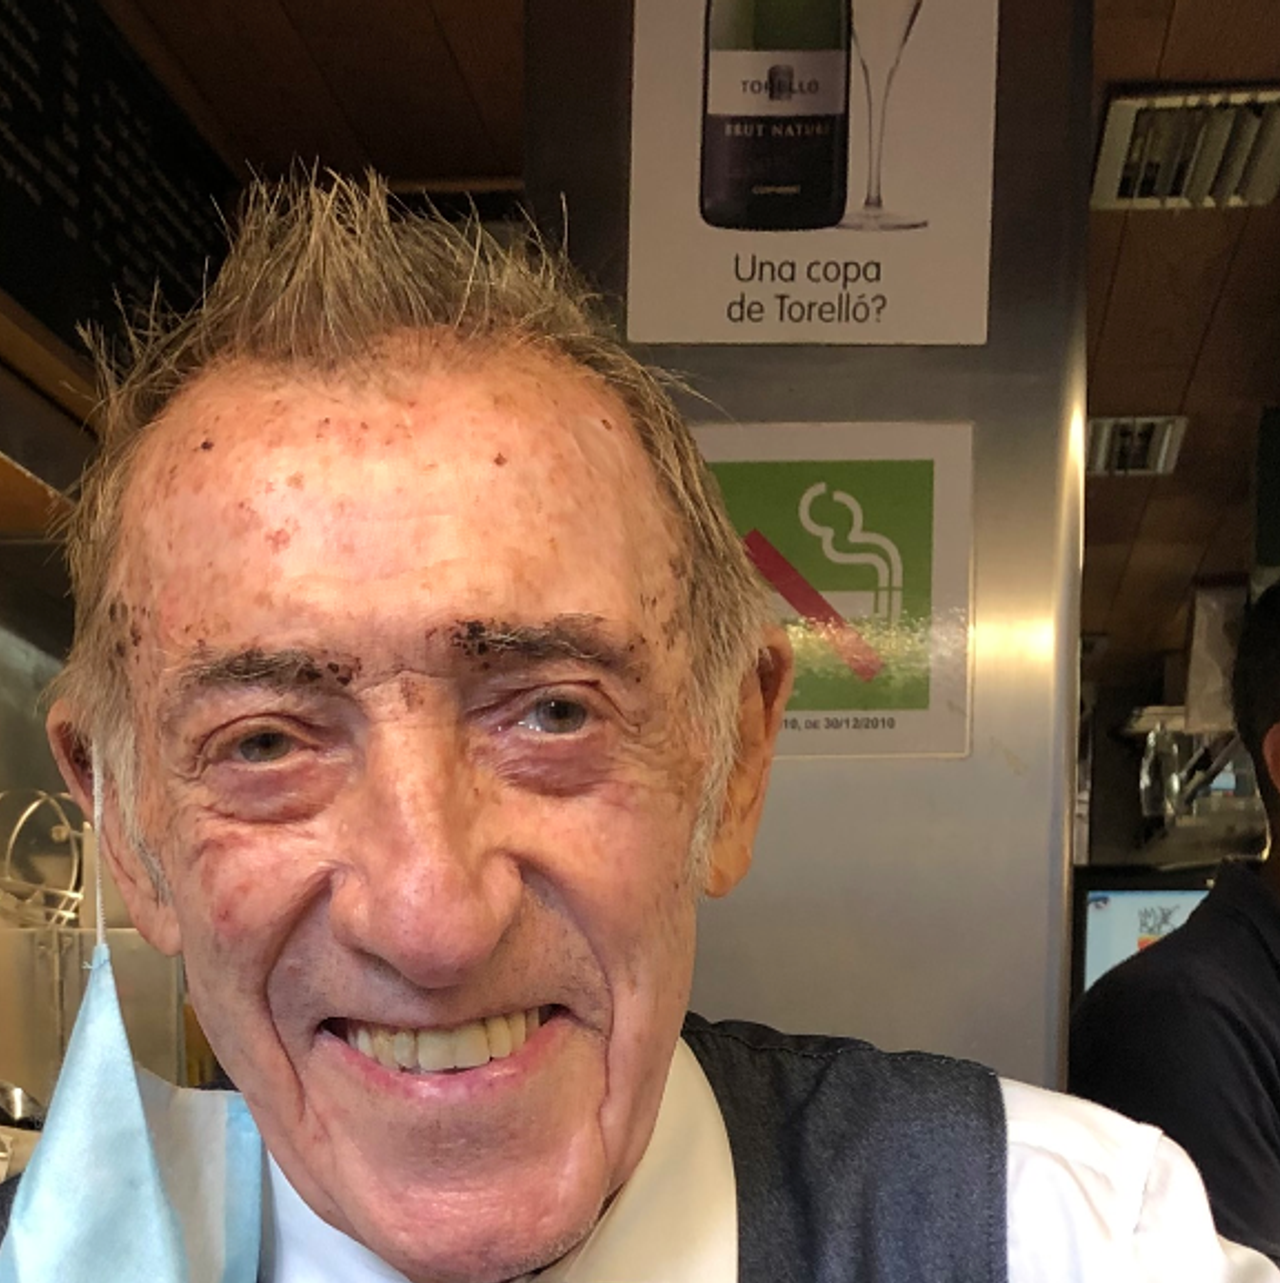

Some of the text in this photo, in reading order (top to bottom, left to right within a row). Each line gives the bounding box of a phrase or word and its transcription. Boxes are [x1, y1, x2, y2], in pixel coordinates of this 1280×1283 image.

[724, 123, 764, 138] BRUT
[733, 253, 882, 290] Una copa
[726, 293, 887, 325] de Torelló?
